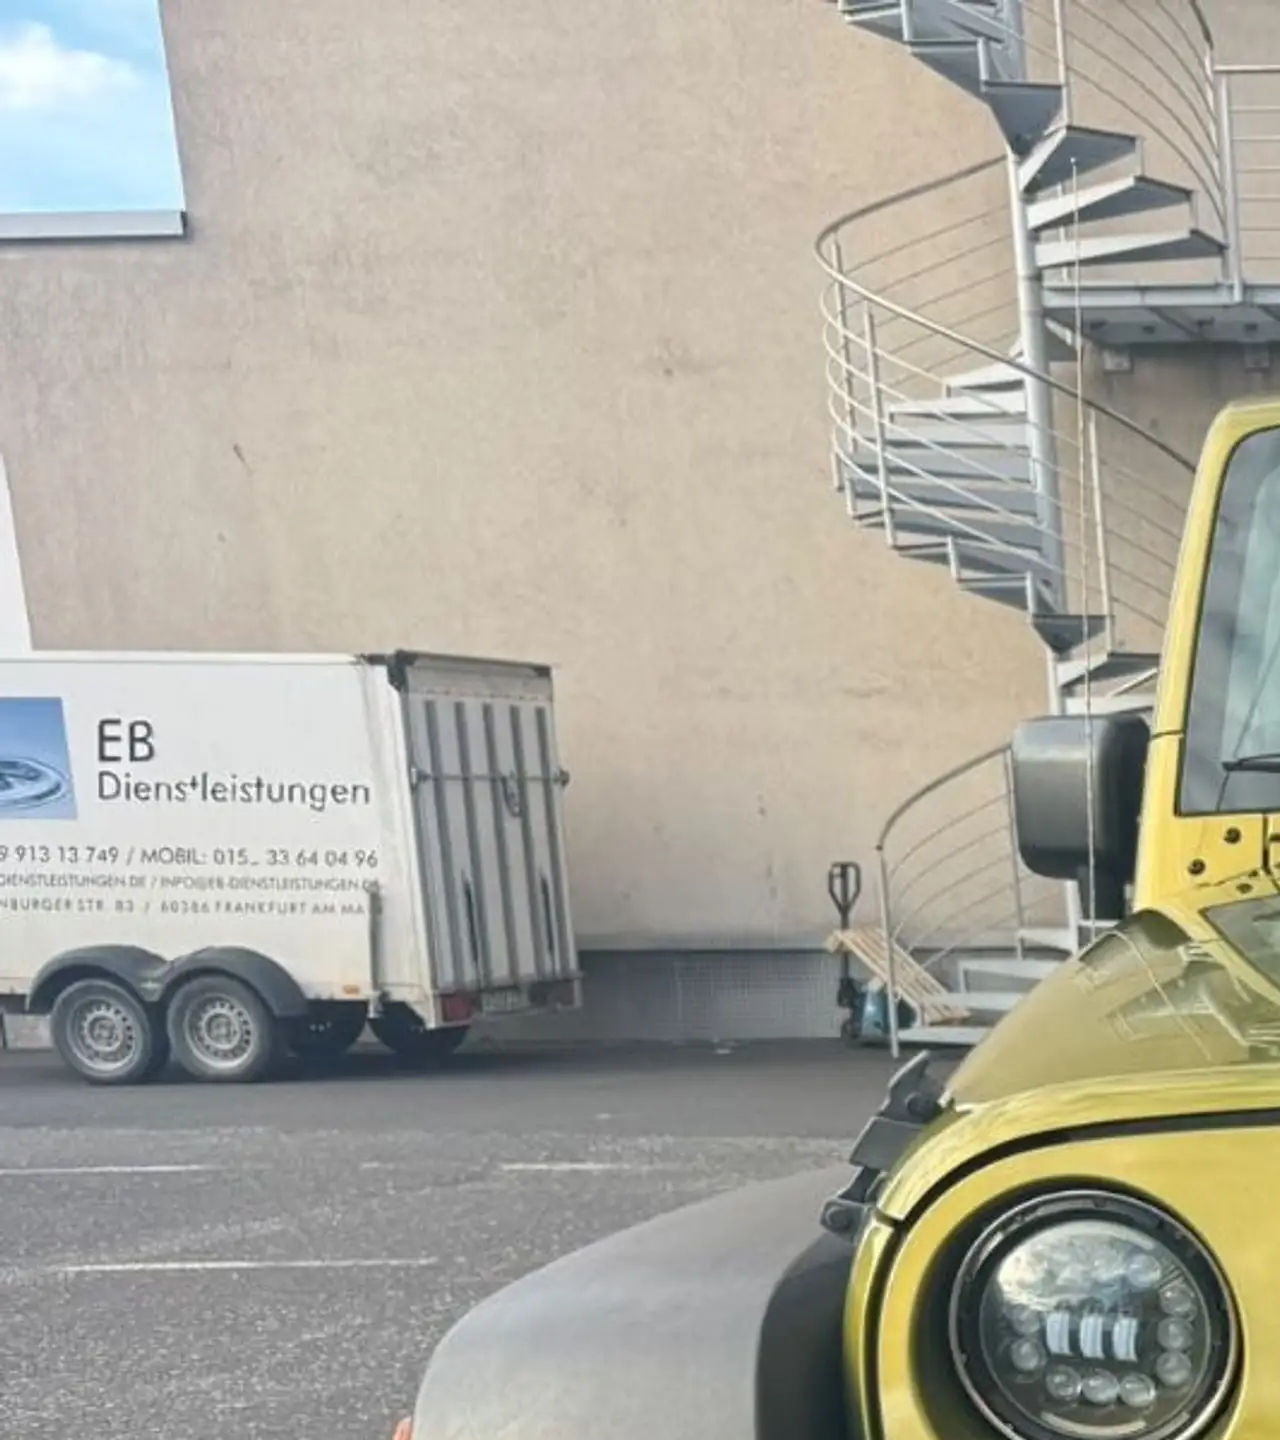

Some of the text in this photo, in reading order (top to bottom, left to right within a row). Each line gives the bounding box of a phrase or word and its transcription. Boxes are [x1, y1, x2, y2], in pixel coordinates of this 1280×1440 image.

[97, 718, 155, 762] EB
[97, 770, 371, 811] Dienstleistungen
[15, 845, 50, 862] 913
[58, 846, 78, 863] 13
[86, 846, 119, 864] 749
[267, 849, 289, 866] 33
[296, 850, 318, 866] 64
[356, 850, 378, 868] 96
